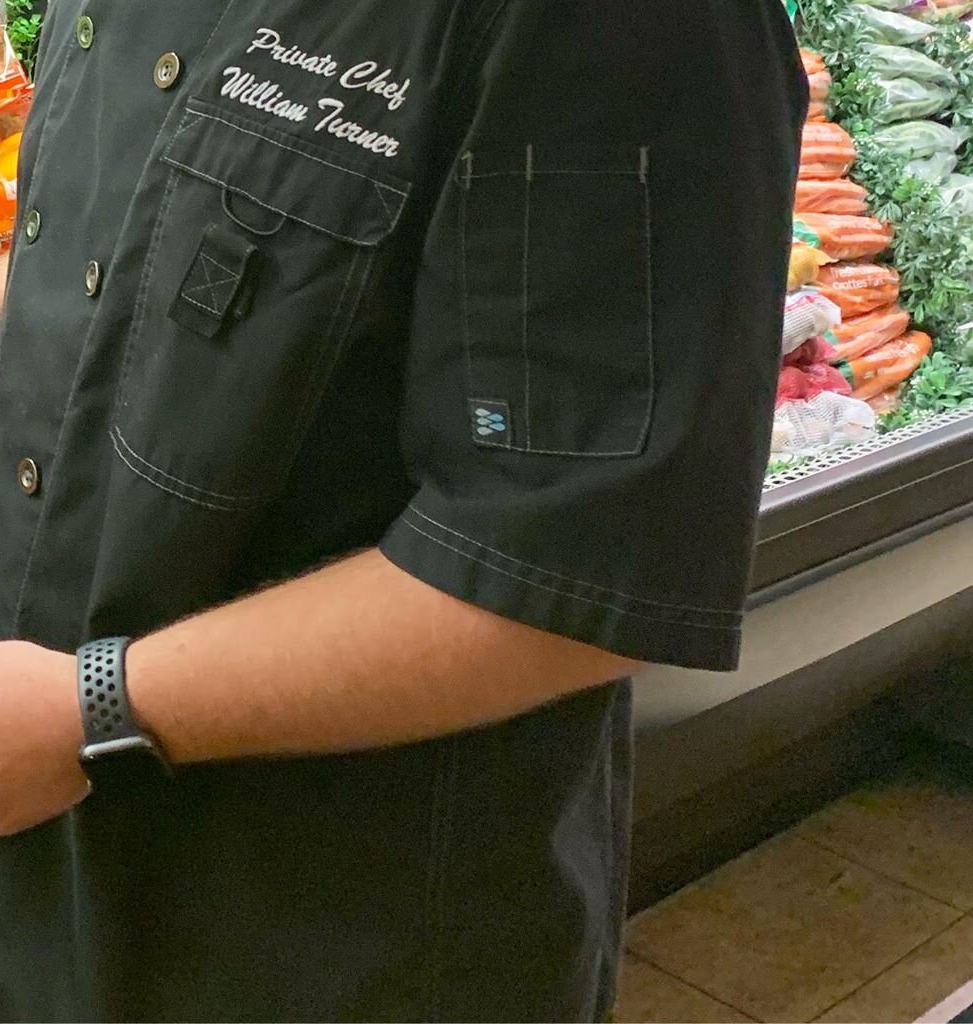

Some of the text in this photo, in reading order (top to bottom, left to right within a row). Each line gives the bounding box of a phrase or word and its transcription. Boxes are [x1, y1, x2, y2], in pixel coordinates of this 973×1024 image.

[220, 67, 400, 158] William Turner
[246, 27, 411, 111] Private Chef
